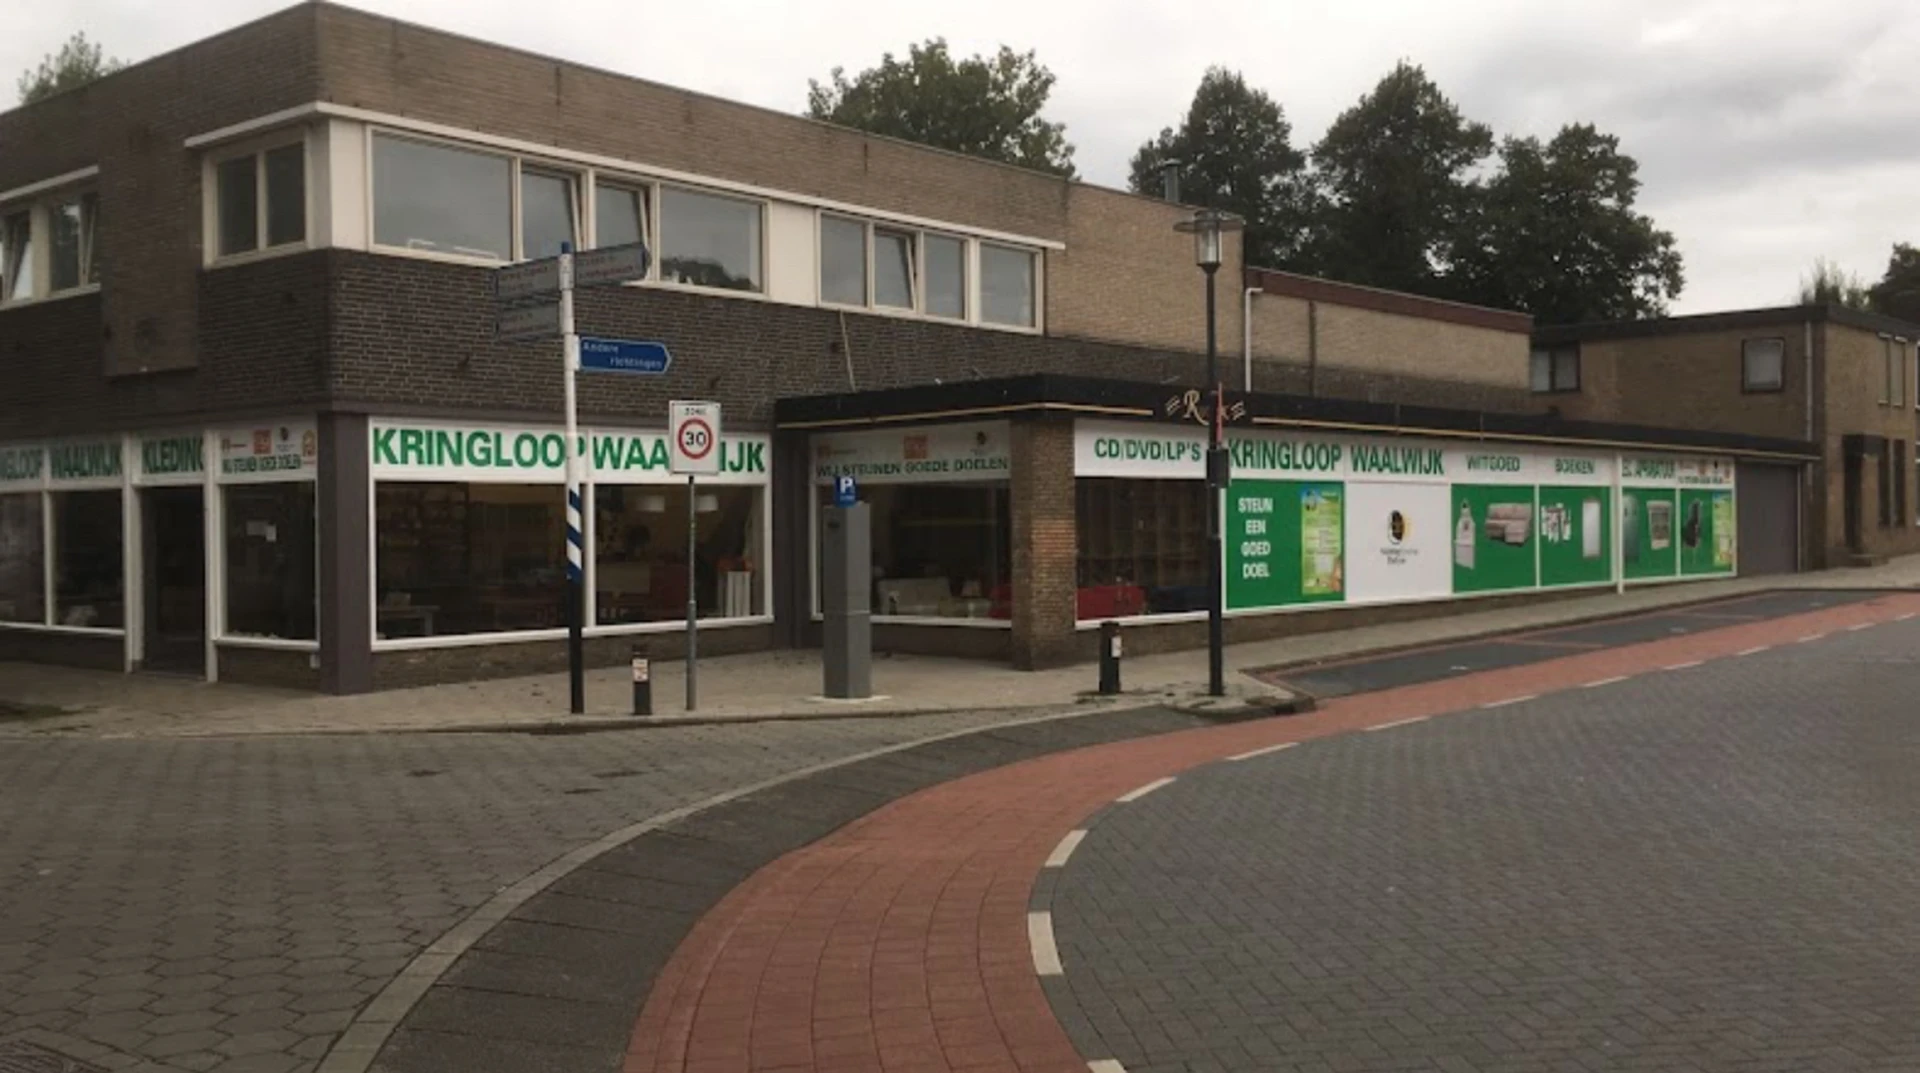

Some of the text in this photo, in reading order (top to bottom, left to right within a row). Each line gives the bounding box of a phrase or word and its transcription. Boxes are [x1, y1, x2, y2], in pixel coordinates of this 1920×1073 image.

[685, 431, 707, 447] 30
[592, 436, 766, 473] WAAIJK
[1228, 438, 1445, 475] KRINGLOOP WAALWIJK
[904, 460, 949, 474] GOEDE
[954, 457, 1008, 472] DOELEN
[1466, 455, 1521, 472] WITGOED
[1555, 458, 1595, 474] BOEKEN
[839, 476, 854, 494] P
[1238, 497, 1274, 513] STEUN
[1245, 519, 1266, 535] EEN
[1240, 541, 1271, 557] GOED
[1242, 562, 1270, 579] DOEL
